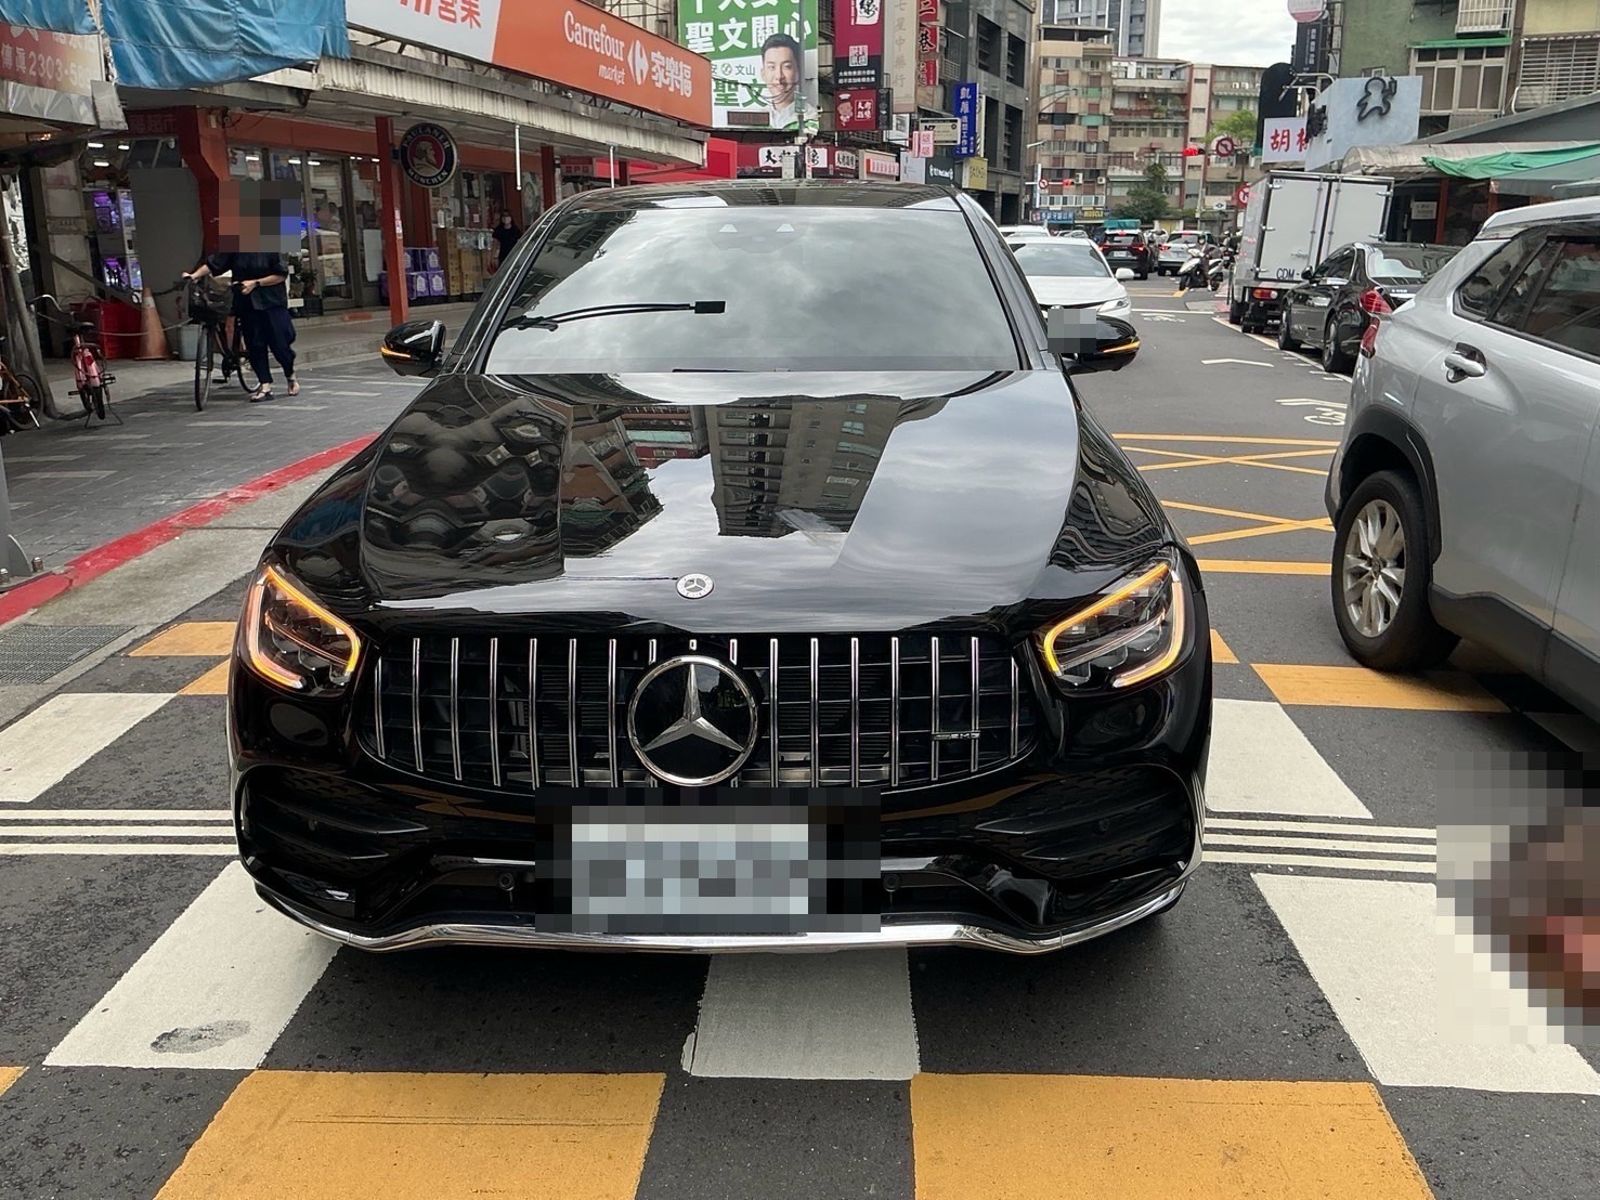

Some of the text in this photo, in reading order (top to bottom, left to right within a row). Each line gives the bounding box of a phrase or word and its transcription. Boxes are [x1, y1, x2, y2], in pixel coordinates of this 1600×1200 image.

[564, 10, 625, 61] Carrefour
[598, 64, 625, 85] market
[651, 51, 692, 97] 家樂福
[735, 64, 756, 76] 文山
[713, 79, 768, 107] 聖文
